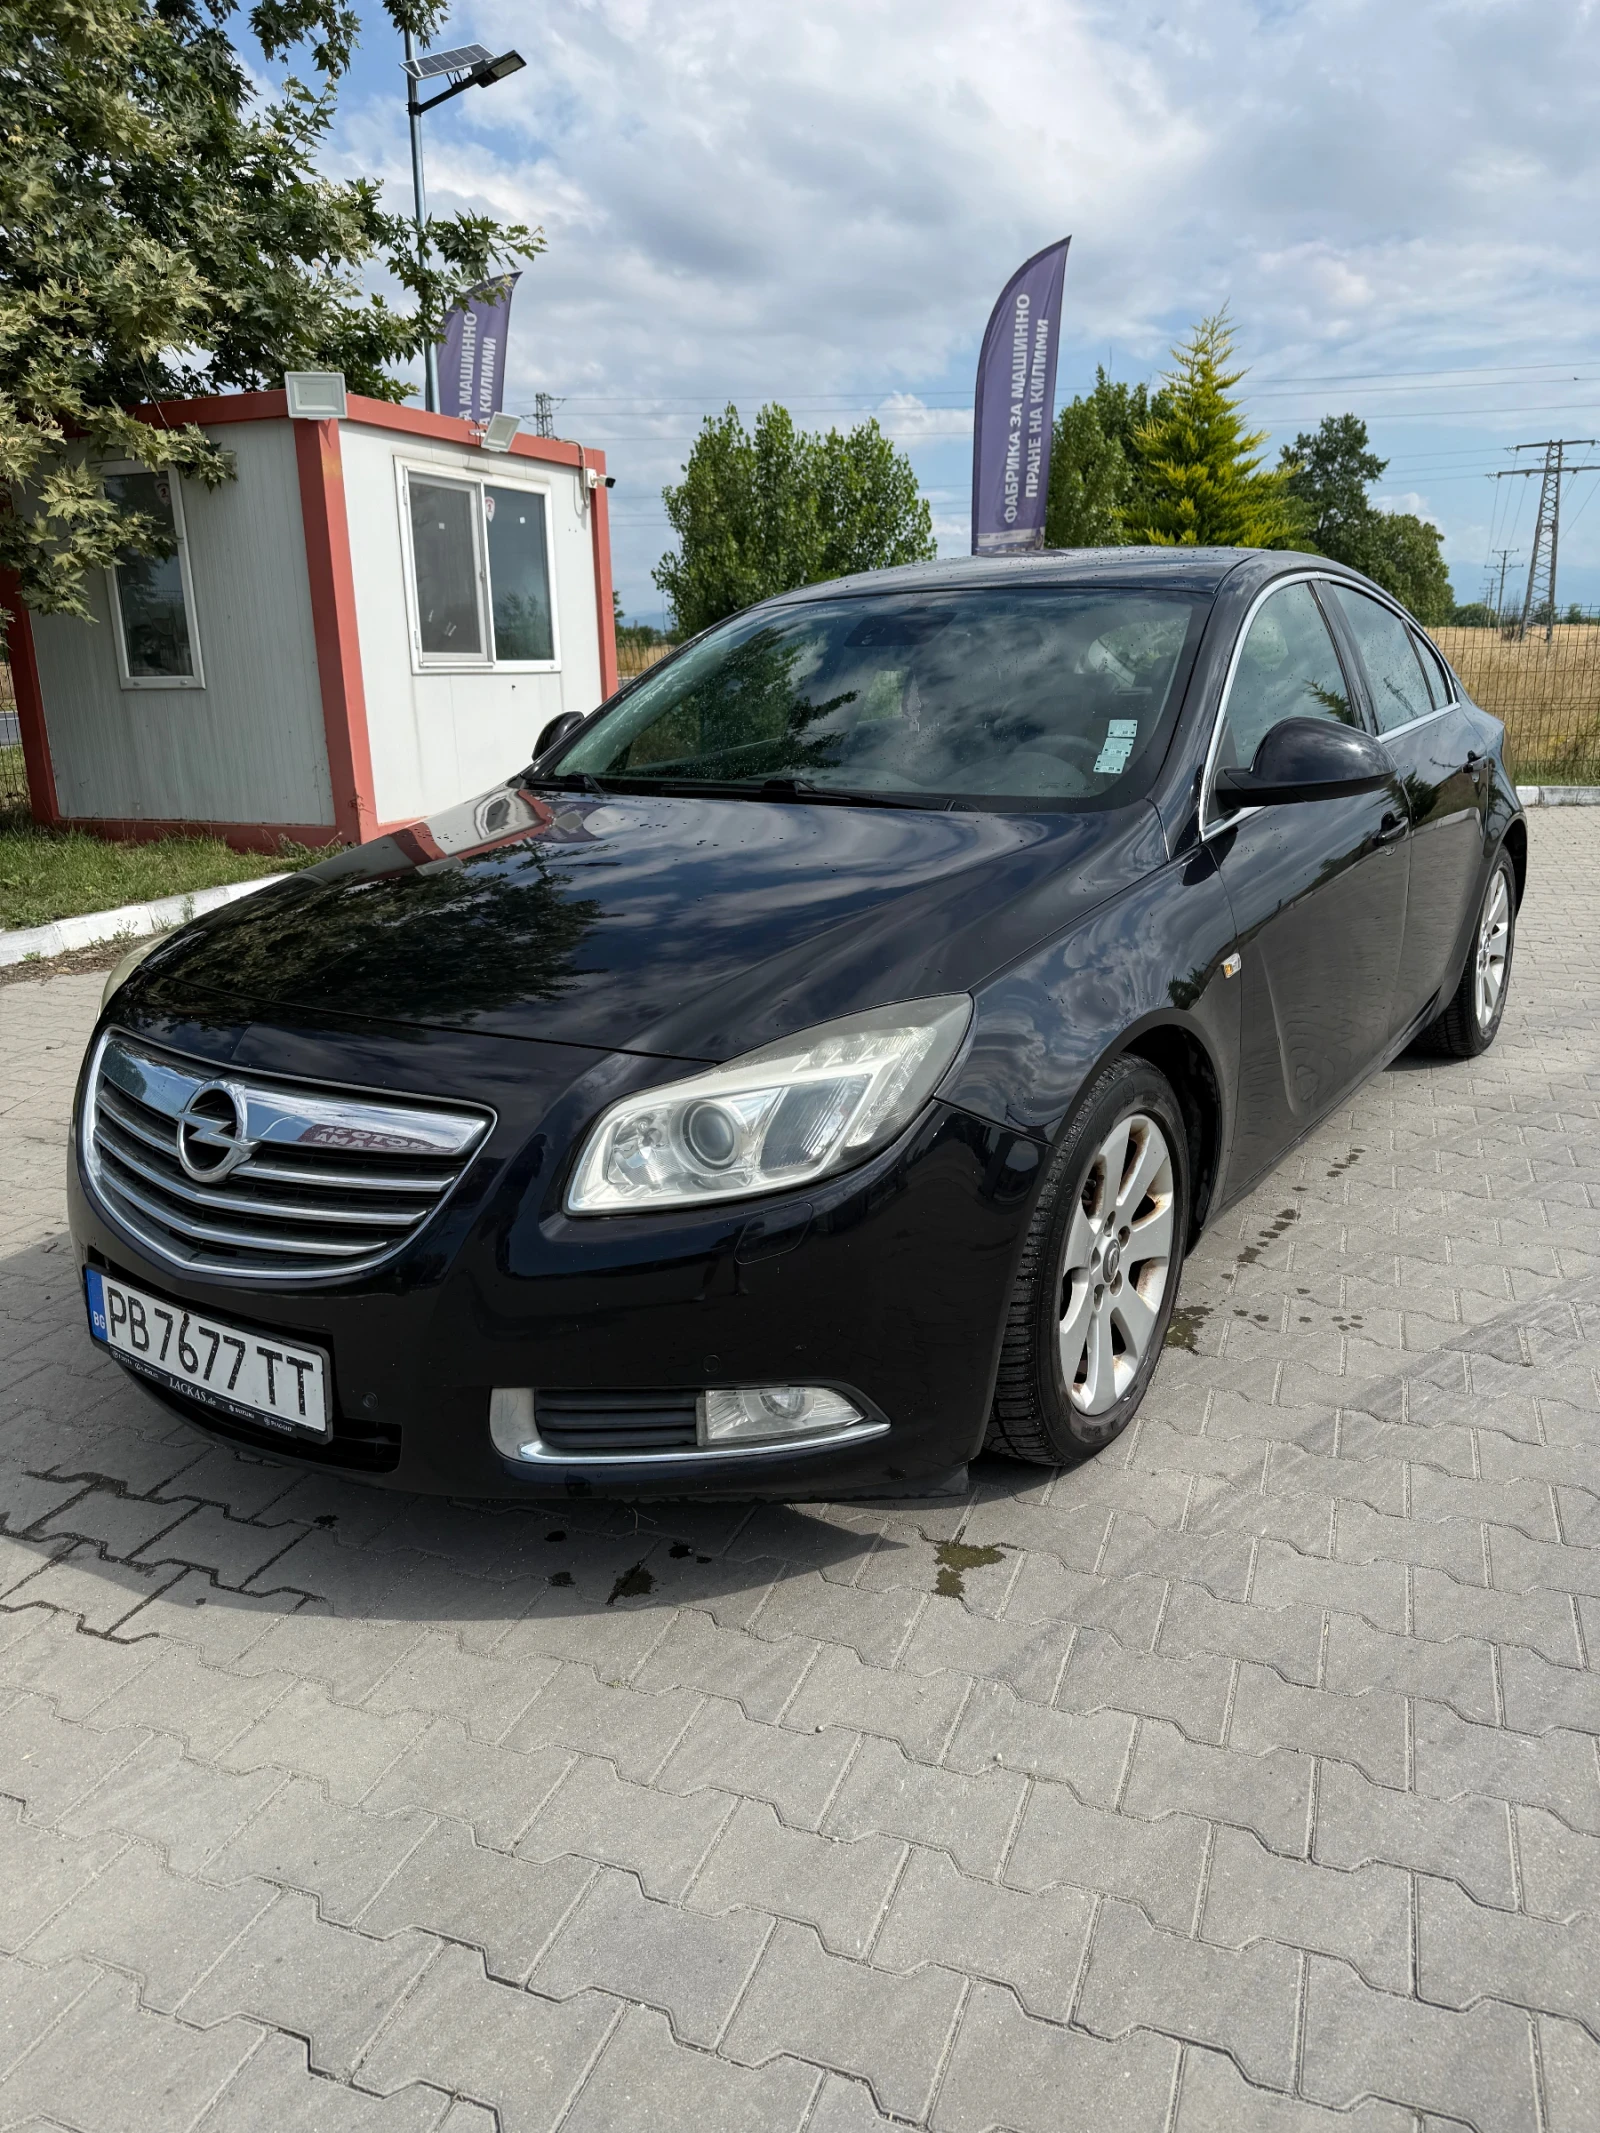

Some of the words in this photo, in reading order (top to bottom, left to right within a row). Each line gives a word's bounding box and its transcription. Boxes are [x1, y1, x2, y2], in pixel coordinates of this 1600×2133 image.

[459, 313, 477, 405] МАШИННО
[480, 337, 496, 412] КИЛИМИ
[1011, 294, 1030, 399] МАШИННО
[1030, 318, 1049, 401] КИЛИМИ
[1009, 403, 1023, 428] ЗА
[1028, 406, 1043, 434] НА
[1004, 434, 1021, 524] ФАБРИКА
[1025, 437, 1042, 498] ПРАНЕ
[93, 1310, 106, 1330] BG
[168, 1376, 217, 1407] LACKAS.de
